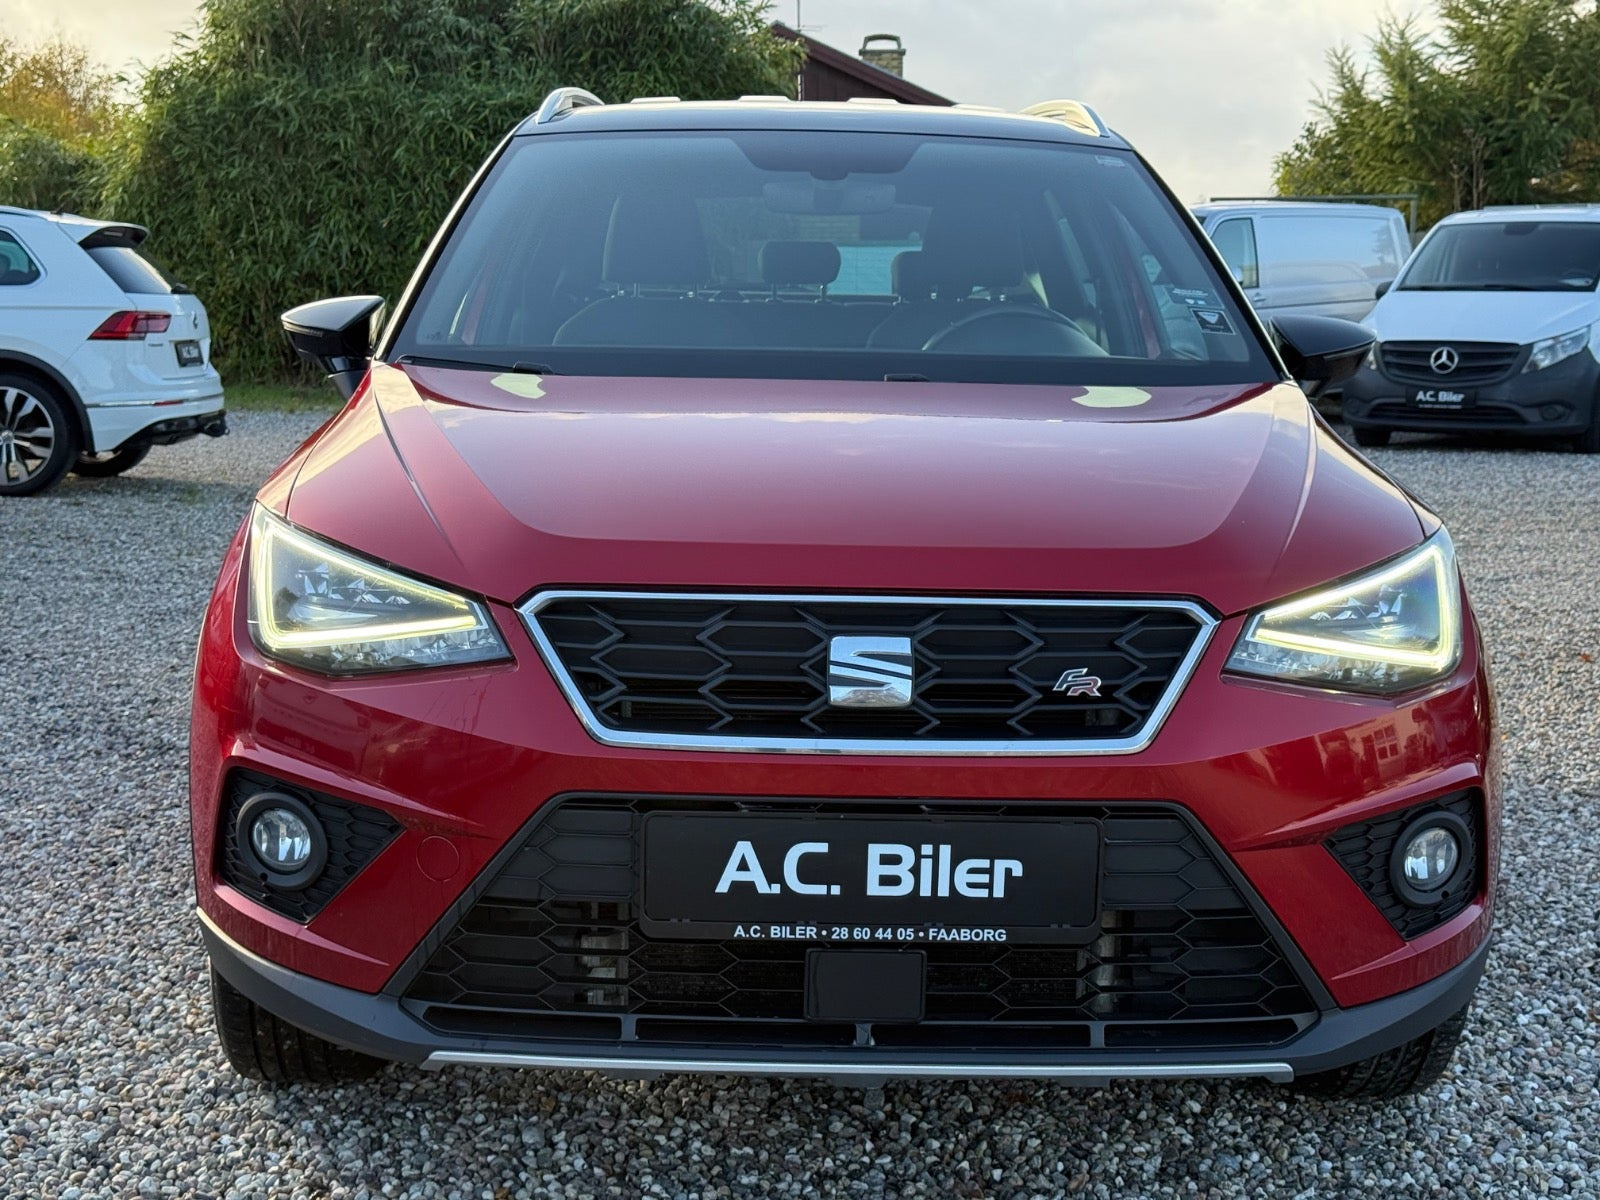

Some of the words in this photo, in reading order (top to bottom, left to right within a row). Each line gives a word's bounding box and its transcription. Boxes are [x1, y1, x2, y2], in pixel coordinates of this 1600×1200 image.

[1052, 668, 1102, 697] FR
[715, 841, 841, 896] A.C.
[866, 843, 1024, 898] Biler
[733, 925, 766, 939] A.C.
[770, 925, 818, 940] BILER
[831, 926, 849, 940] 28
[853, 927, 871, 940] 60
[874, 927, 893, 941] 44
[896, 927, 915, 941] 05
[928, 928, 1007, 942] FAABORG
